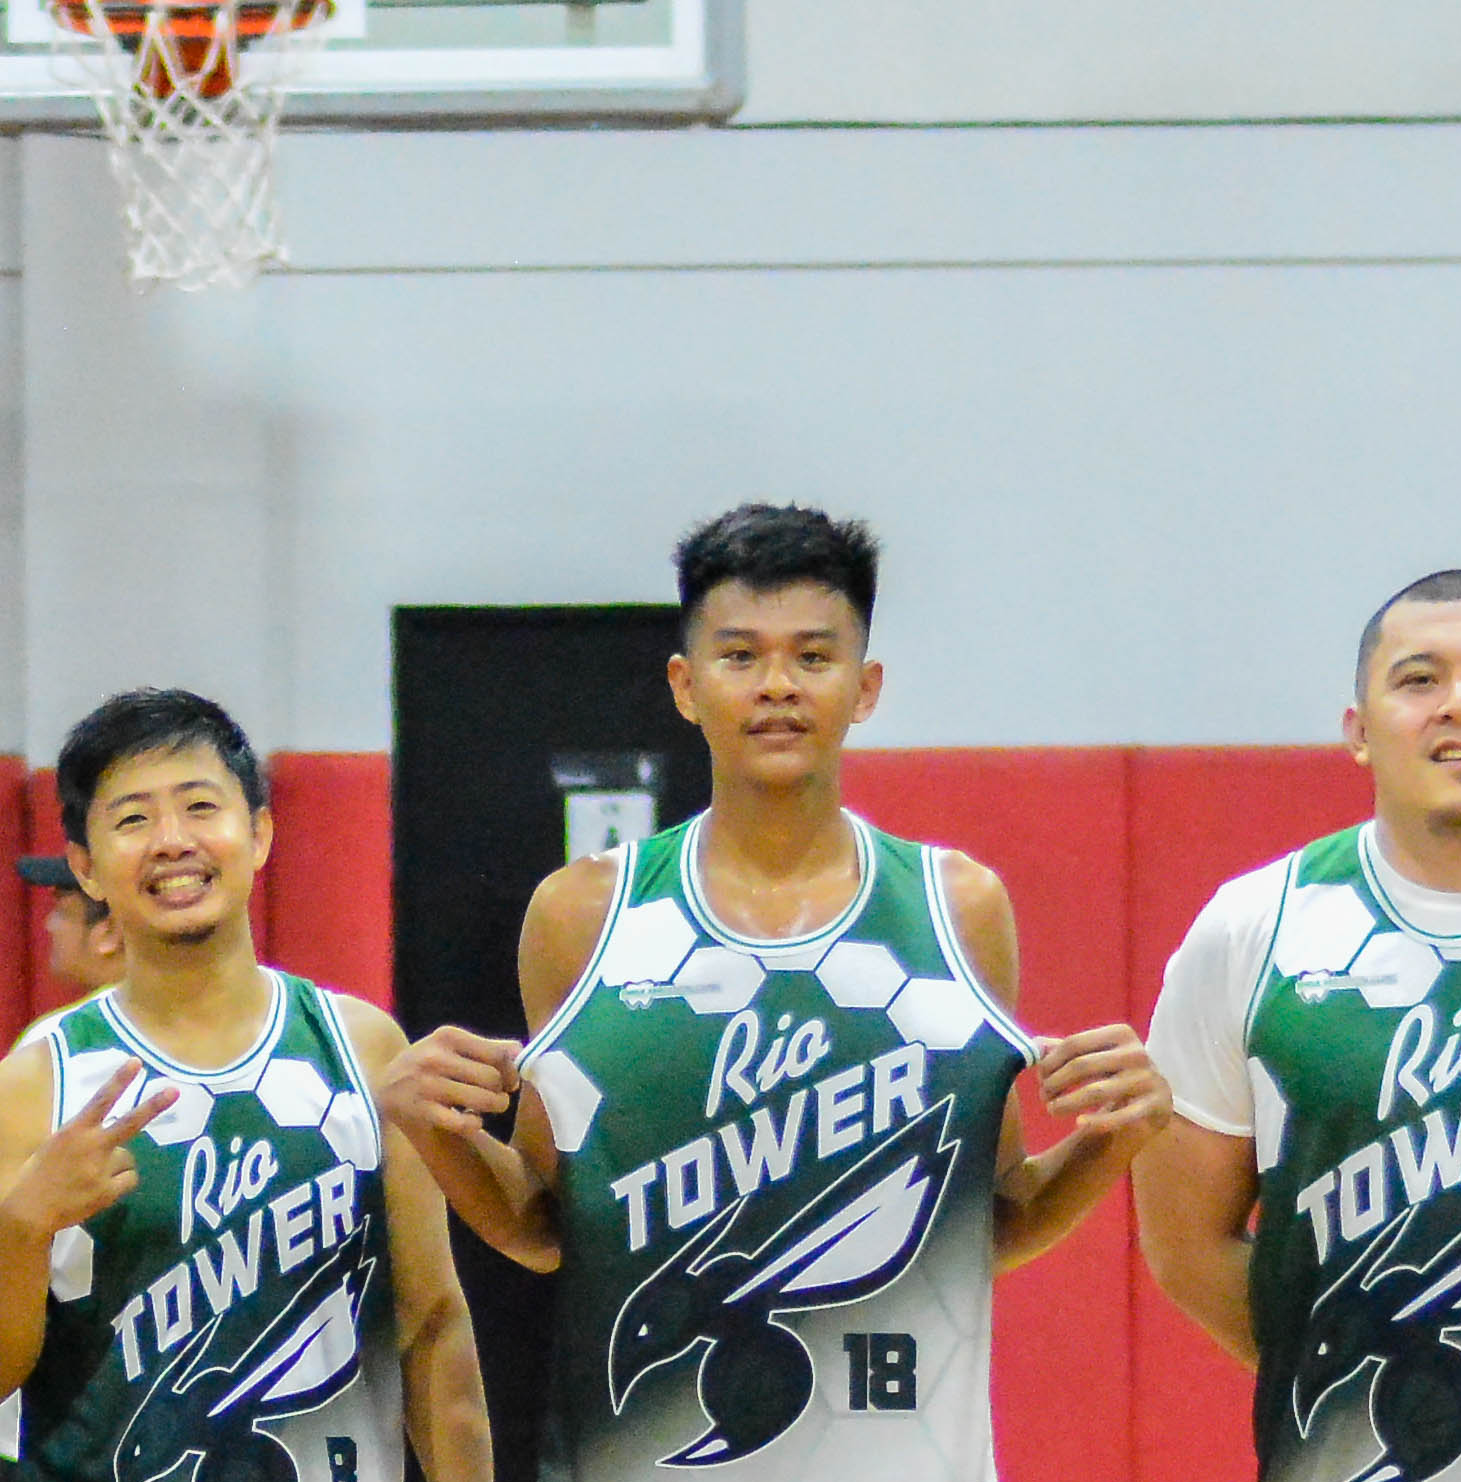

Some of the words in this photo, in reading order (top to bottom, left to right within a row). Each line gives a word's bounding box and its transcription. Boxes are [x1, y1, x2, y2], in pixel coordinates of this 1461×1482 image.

[706, 1010, 829, 1118] Rio
[181, 1136, 278, 1244] Rio
[610, 1043, 925, 1251] TOWER
[110, 1162, 355, 1381] TOWER
[842, 1332, 917, 1411] 18
